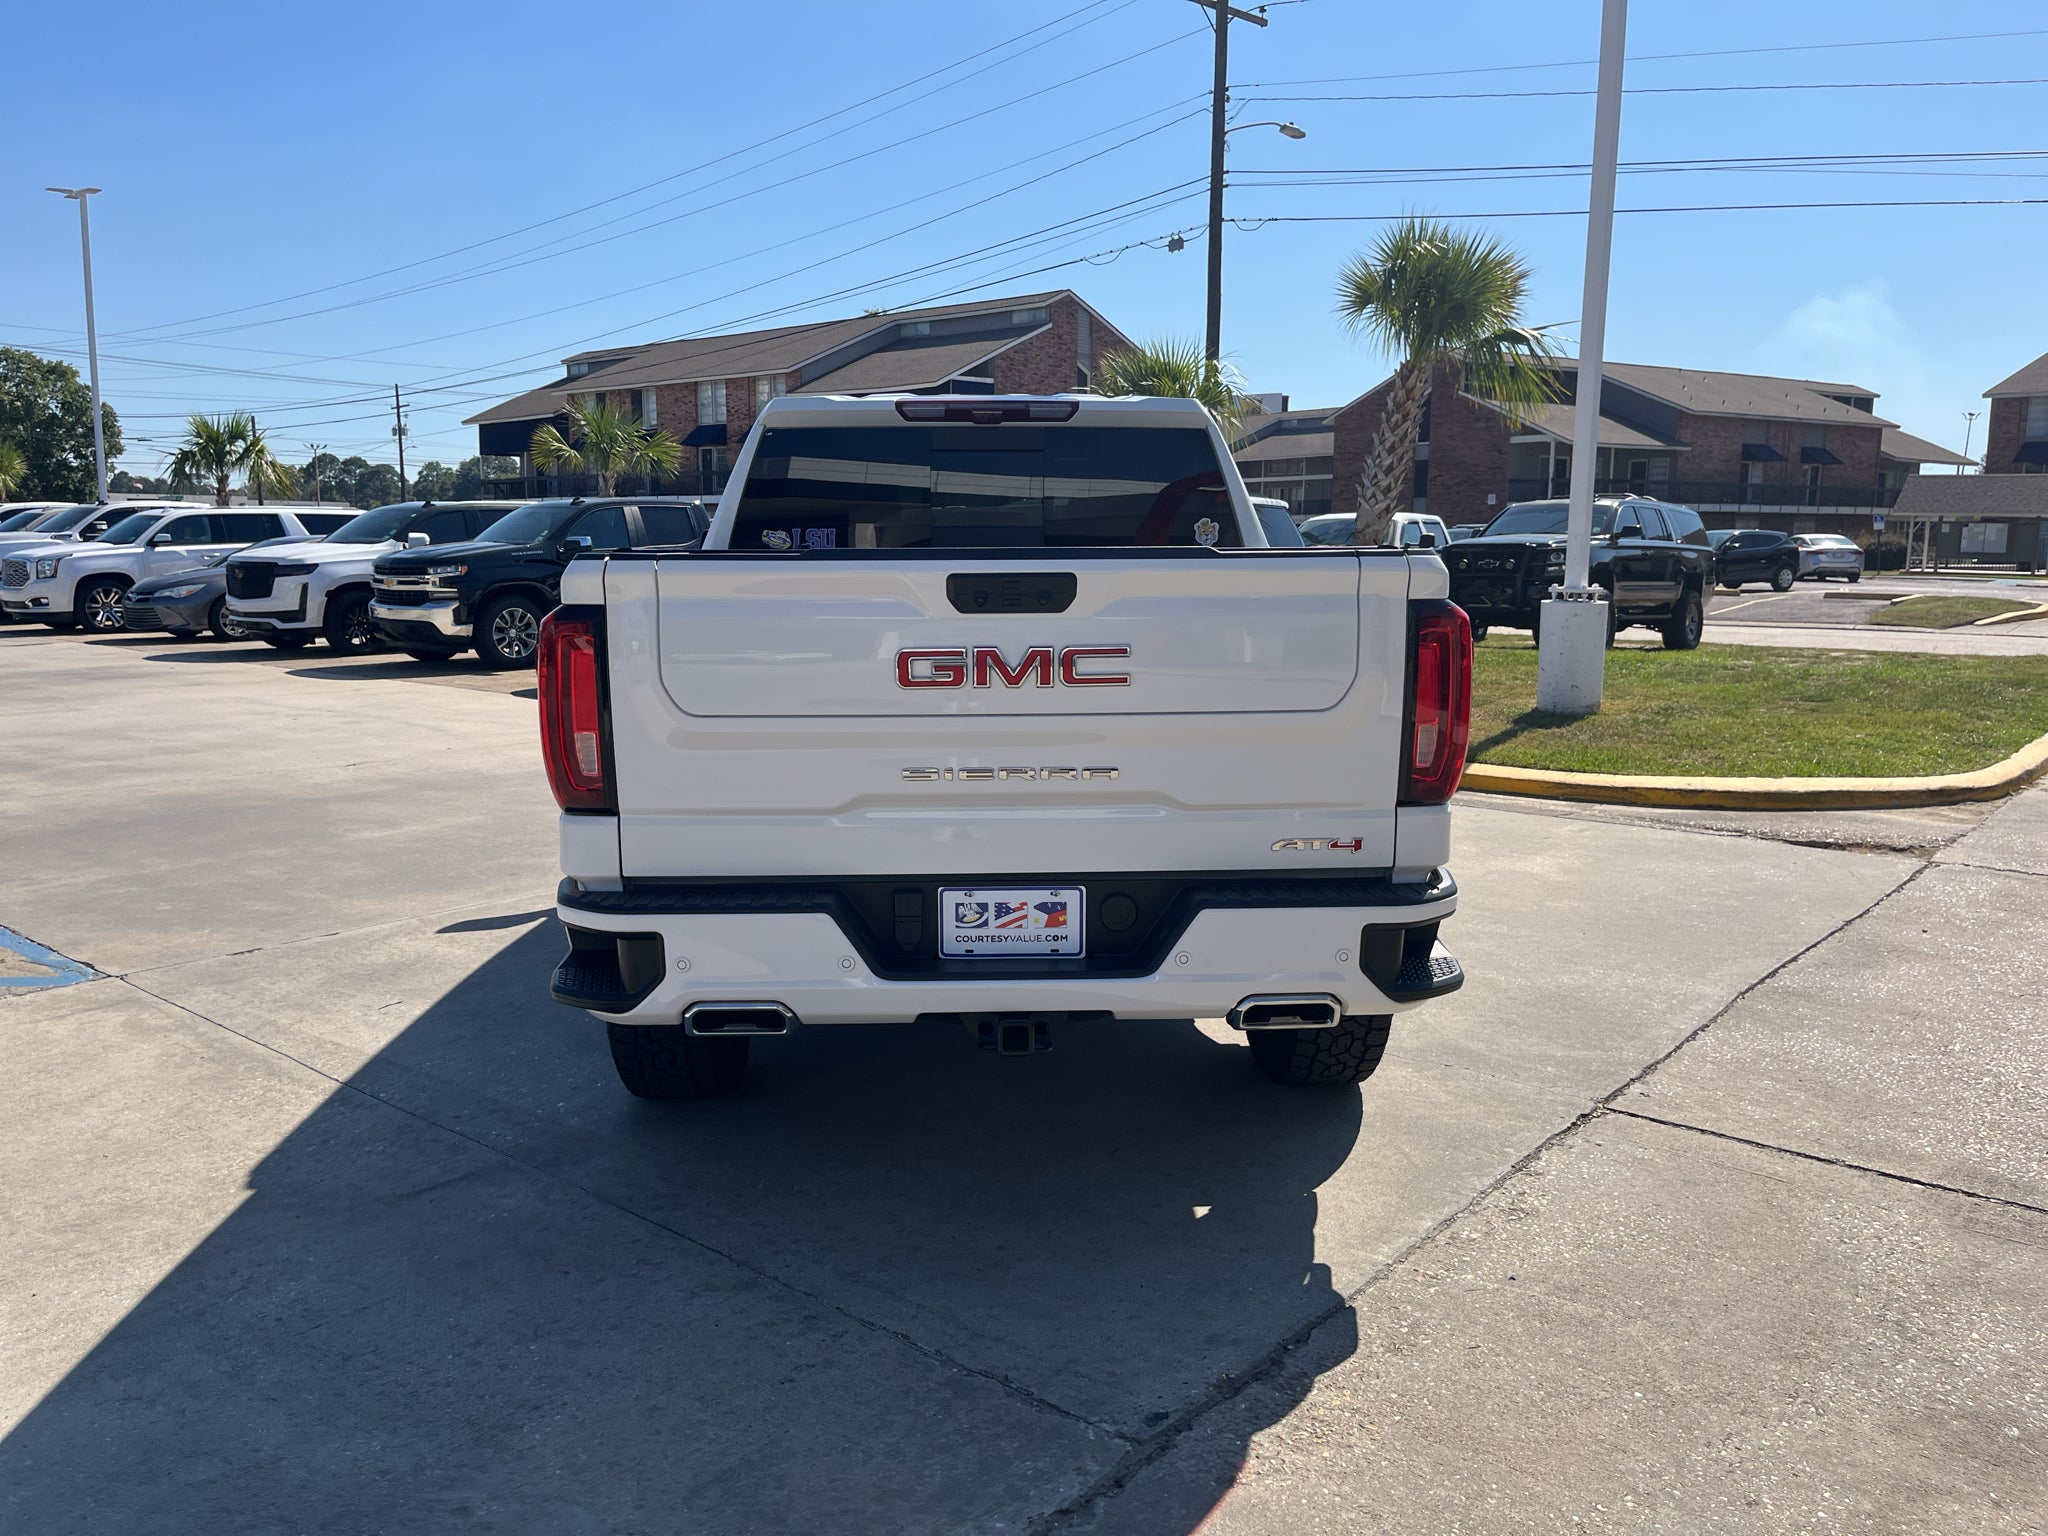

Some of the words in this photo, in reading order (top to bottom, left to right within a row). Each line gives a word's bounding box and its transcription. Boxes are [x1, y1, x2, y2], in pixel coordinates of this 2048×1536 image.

[792, 529, 836, 550] LSU
[896, 645, 1131, 689] GMC
[902, 767, 1120, 781] SIERRA
[1271, 837, 1364, 854] AT4
[955, 934, 1069, 943] COURTESYVALUE.COM
